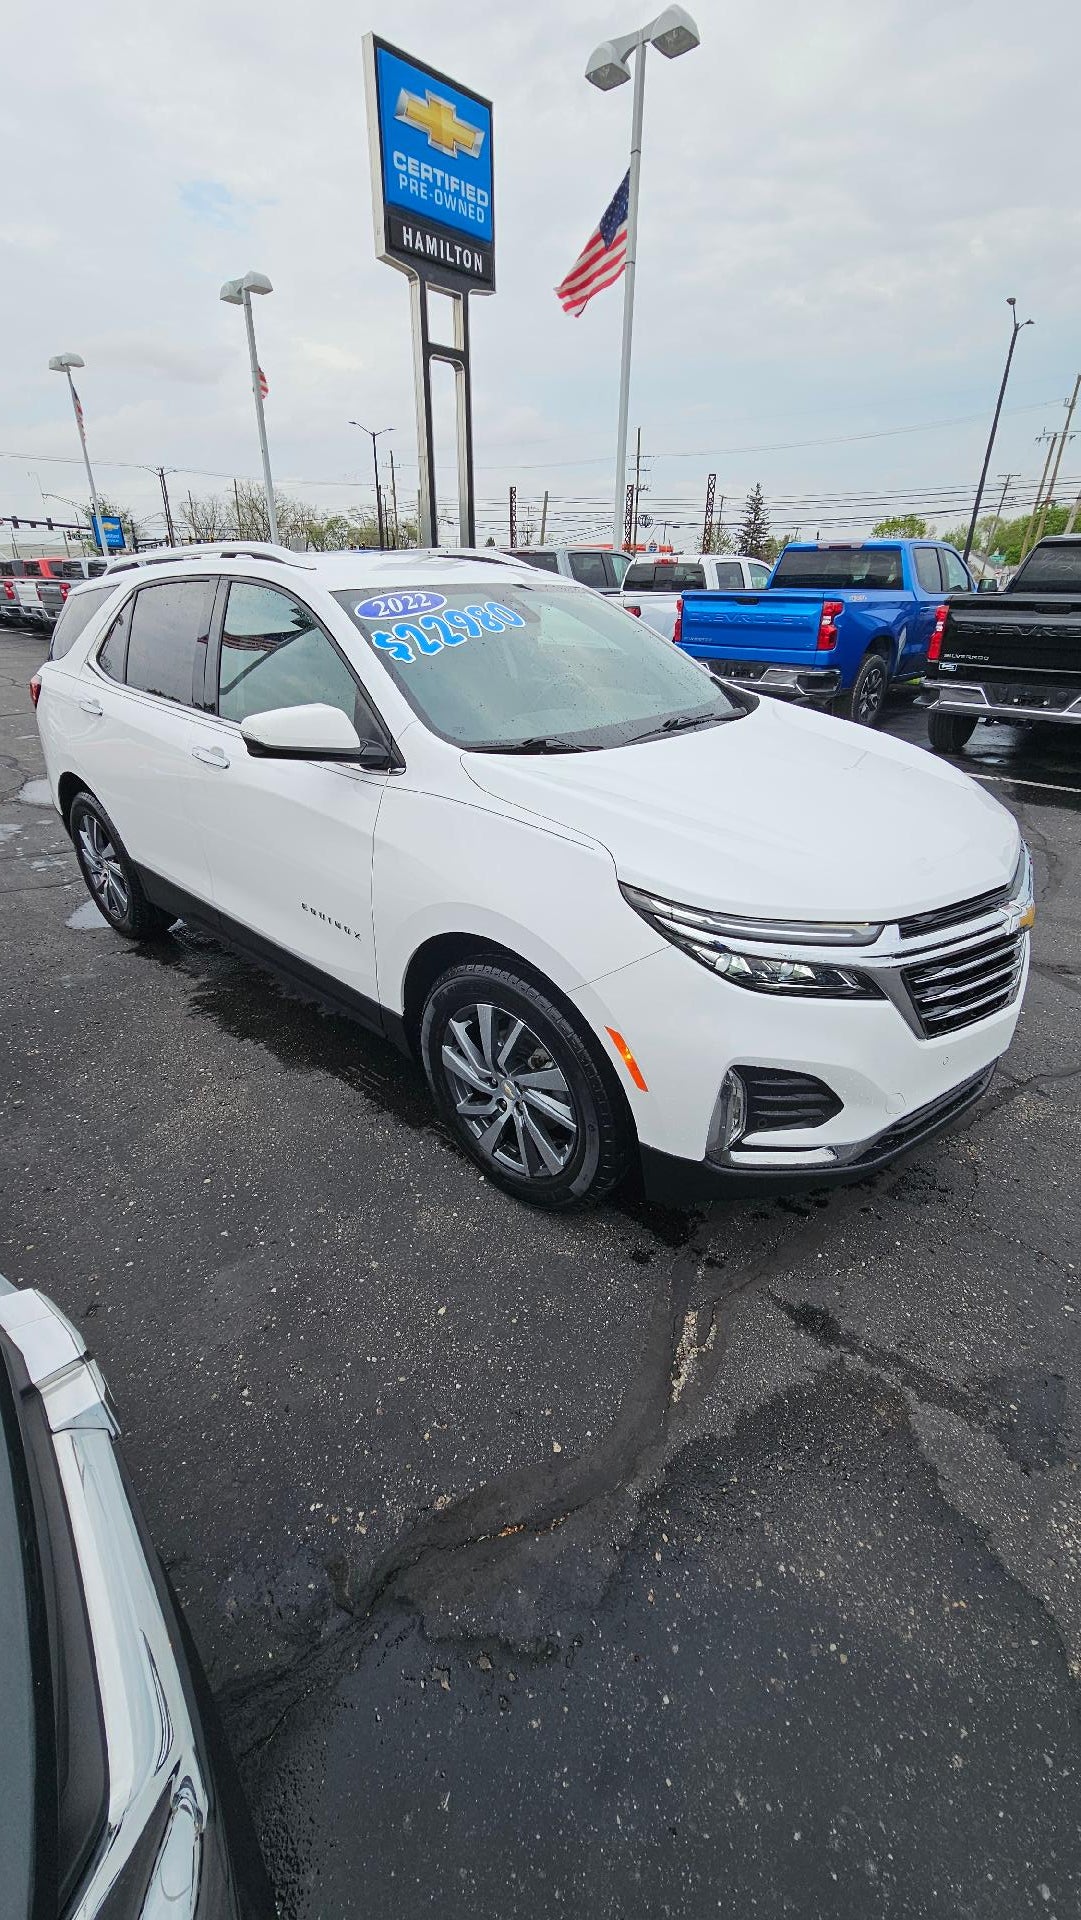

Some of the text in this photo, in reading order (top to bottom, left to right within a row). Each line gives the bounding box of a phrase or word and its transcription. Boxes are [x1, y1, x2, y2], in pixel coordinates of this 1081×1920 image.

[393, 150, 489, 207] CERTIFIED
[398, 173, 485, 224] PRE-OWNED
[402, 225, 483, 273] HAMILTON
[372, 593, 432, 617] 2022
[371, 602, 526, 663] $22980
[301, 902, 362, 941] EQUINOX
